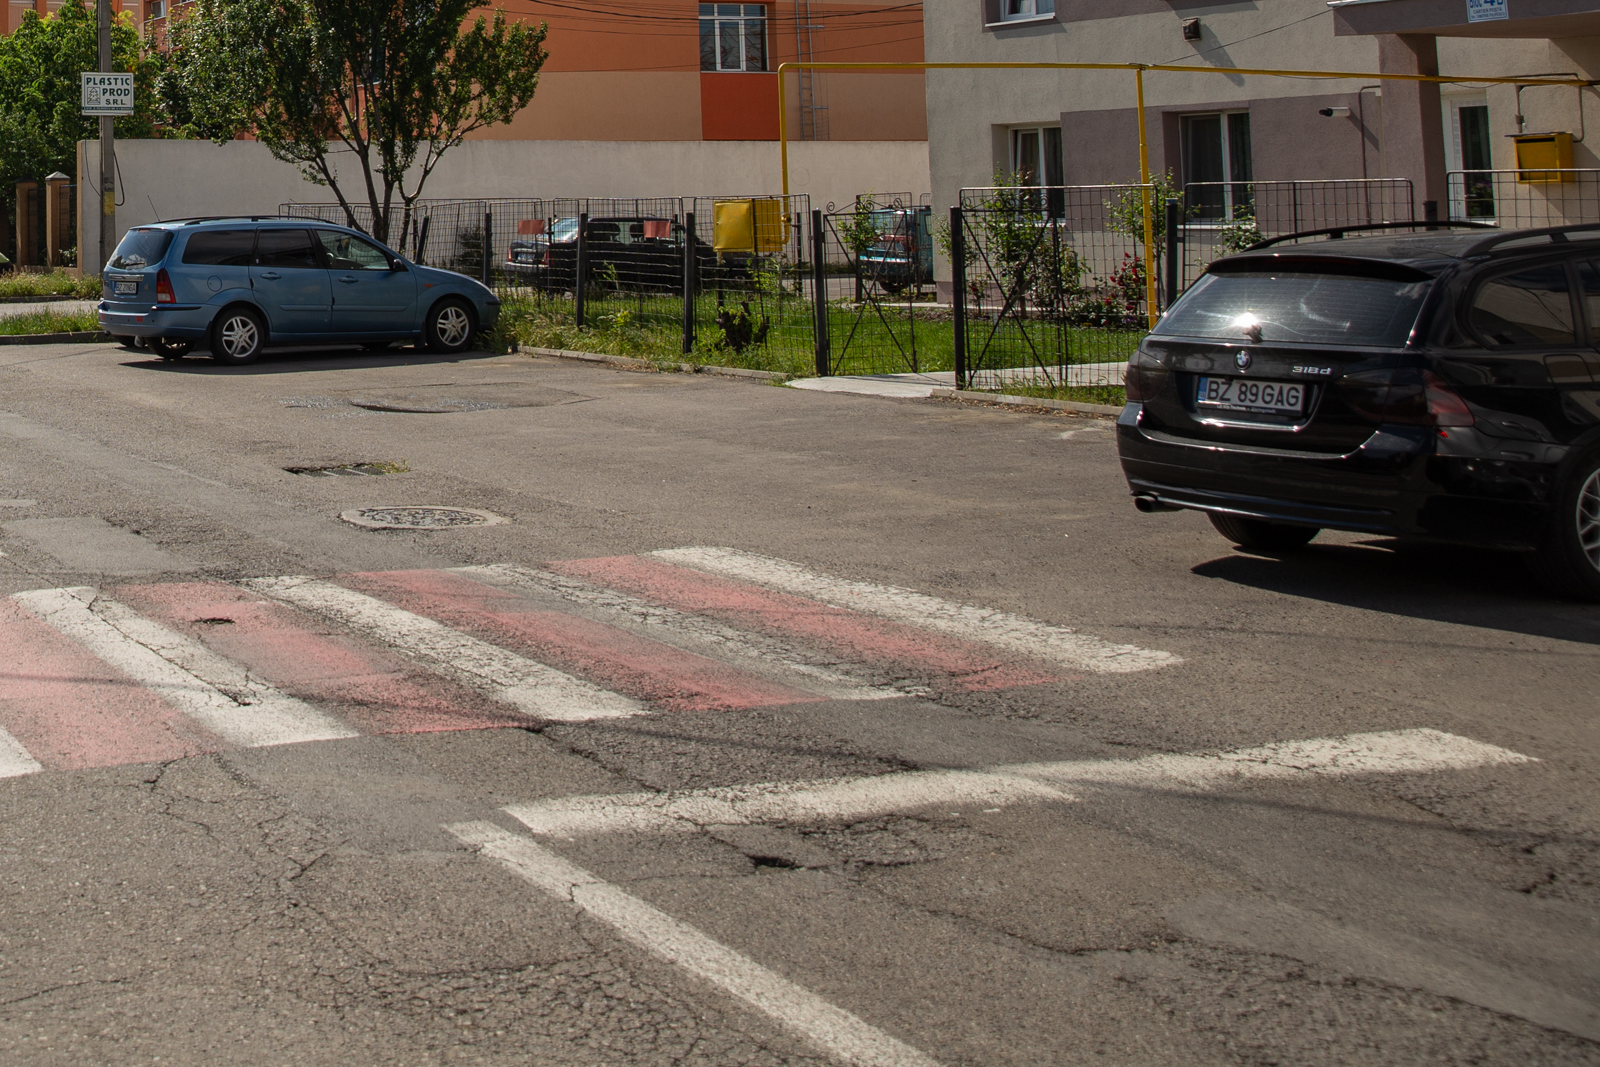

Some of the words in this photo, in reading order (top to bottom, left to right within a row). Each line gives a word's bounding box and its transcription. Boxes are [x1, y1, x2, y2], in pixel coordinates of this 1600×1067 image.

[86, 77, 130, 86] PLASTIC
[102, 88, 130, 97] PROD
[1292, 366, 1332, 375] 318d
[1207, 380, 1233, 401] BZ
